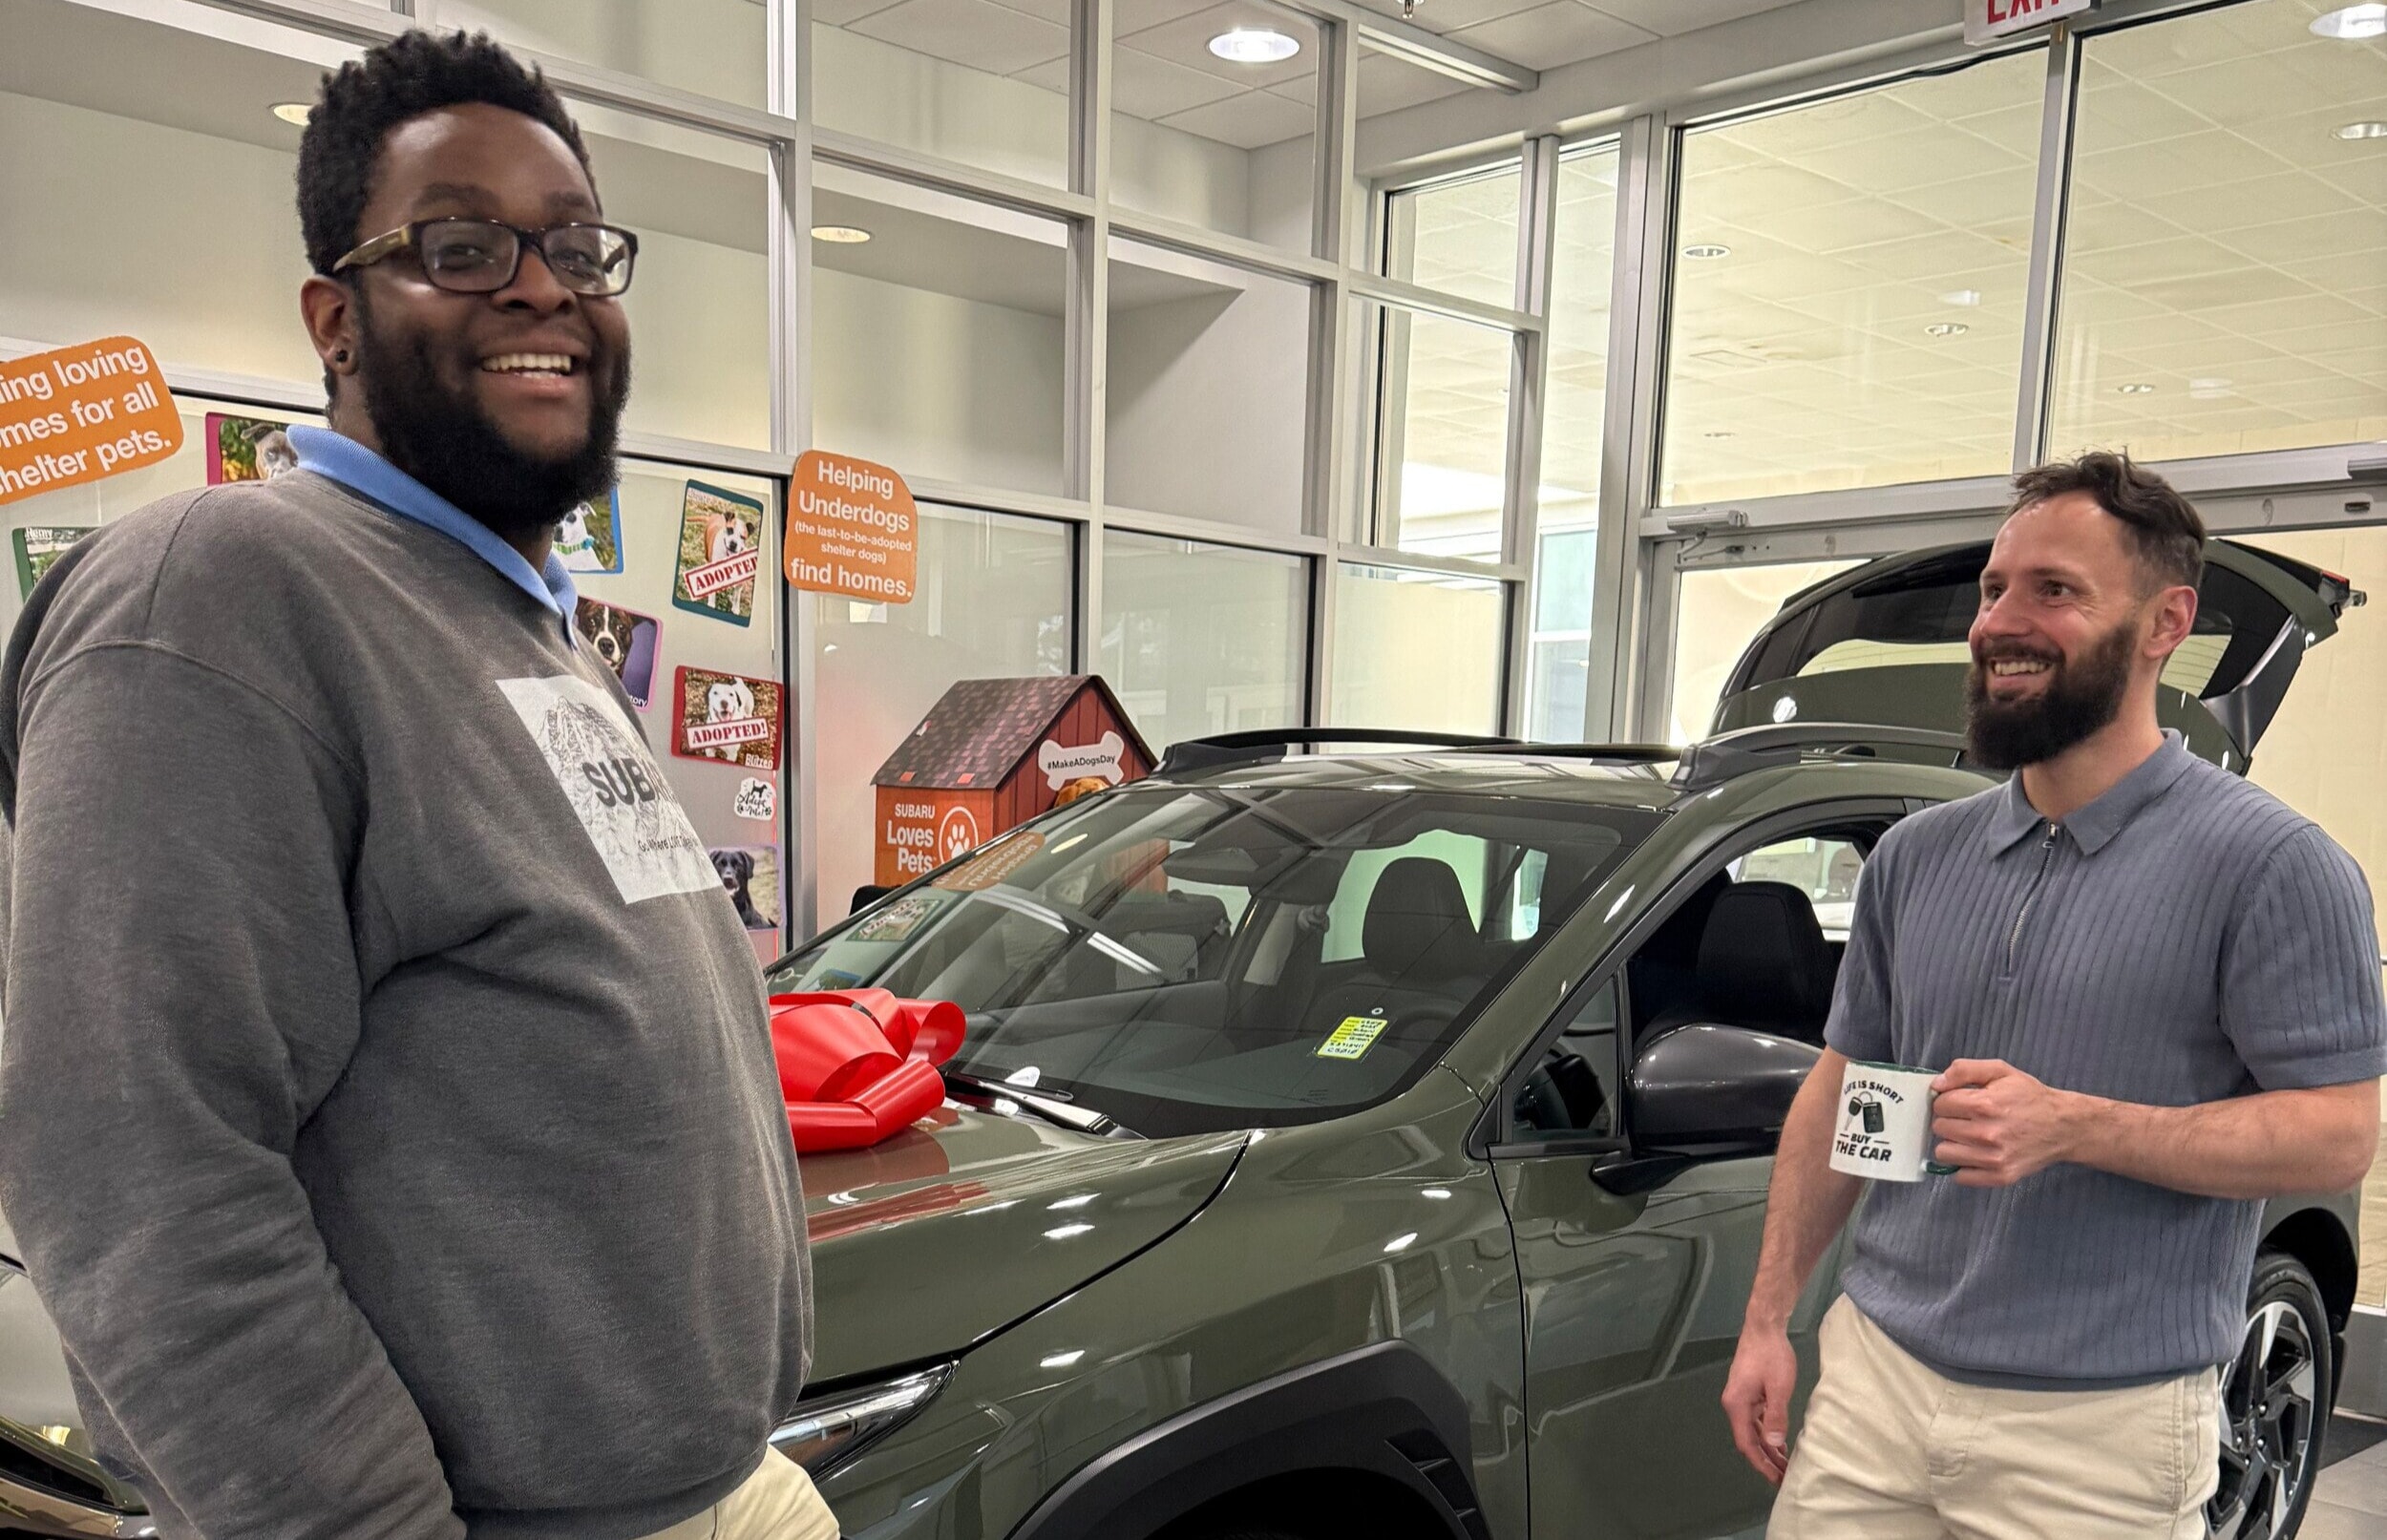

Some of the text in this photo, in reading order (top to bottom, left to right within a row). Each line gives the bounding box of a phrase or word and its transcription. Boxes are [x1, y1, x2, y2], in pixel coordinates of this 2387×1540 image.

[0, 347, 149, 404] ing loving
[0, 381, 159, 449] mes for all
[95, 430, 173, 472] pets.
[817, 459, 894, 500] Helping
[799, 490, 910, 534] Underdogs
[794, 520, 912, 551] (the last-to-be-adopted
[821, 542, 887, 565] shelter dogs)
[791, 558, 912, 598] find homes.
[692, 723, 767, 744] ADOPTED!
[1047, 754, 1115, 770] #MakeADogsDay
[895, 803, 936, 819] SUBARU
[887, 819, 935, 848] Loves
[898, 847, 933, 874] Pets
[1858, 1080, 1867, 1088] IS
[1869, 1081, 1904, 1104] SHORT
[1836, 1140, 1892, 1162] THE CAR
[1850, 1133, 1871, 1145] BUY
